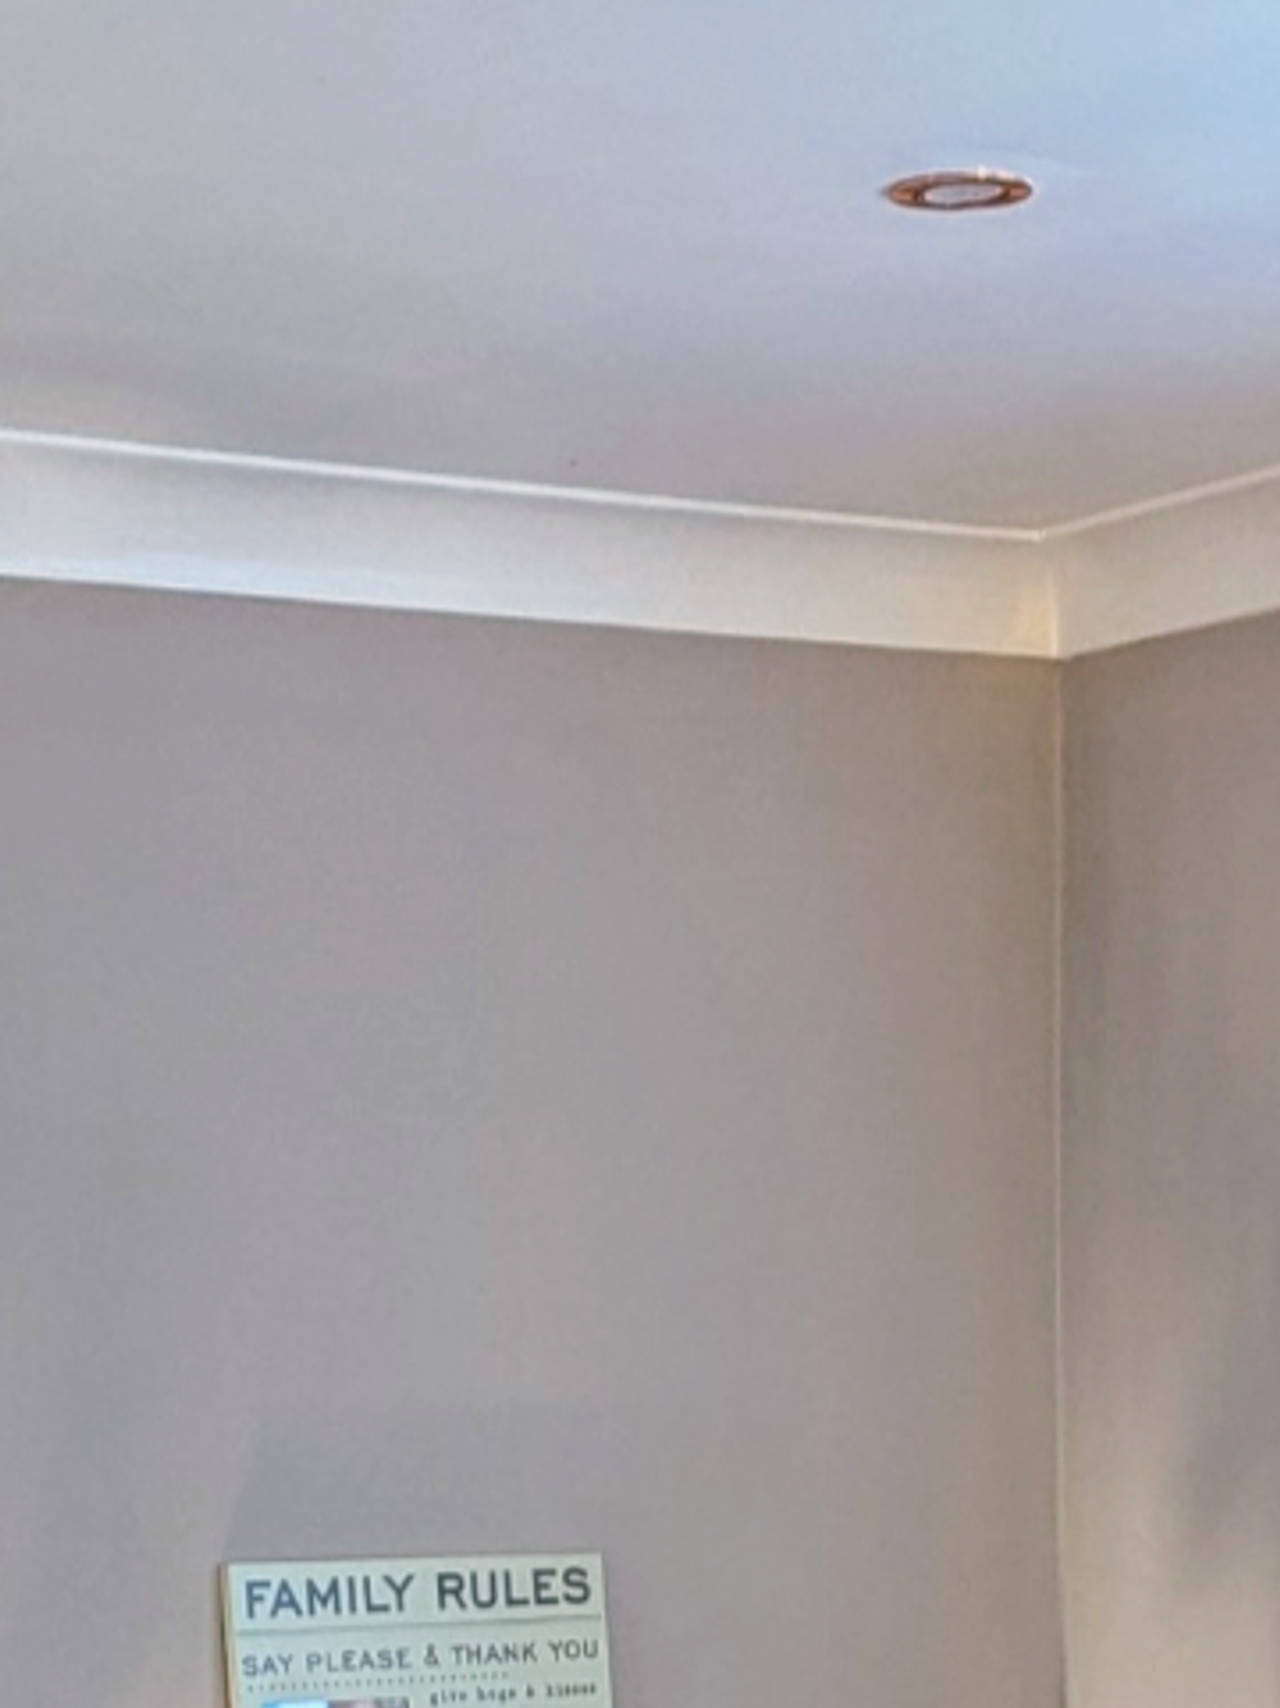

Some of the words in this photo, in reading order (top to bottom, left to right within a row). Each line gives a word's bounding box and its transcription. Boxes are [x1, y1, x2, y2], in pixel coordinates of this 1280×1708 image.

[245, 1573, 415, 1619] FAMILY
[437, 1565, 591, 1611] RULES
[242, 1653, 293, 1676] SAY
[306, 1648, 412, 1673] PLEASE
[451, 1642, 538, 1665] THANK
[548, 1639, 599, 1662] YOU
